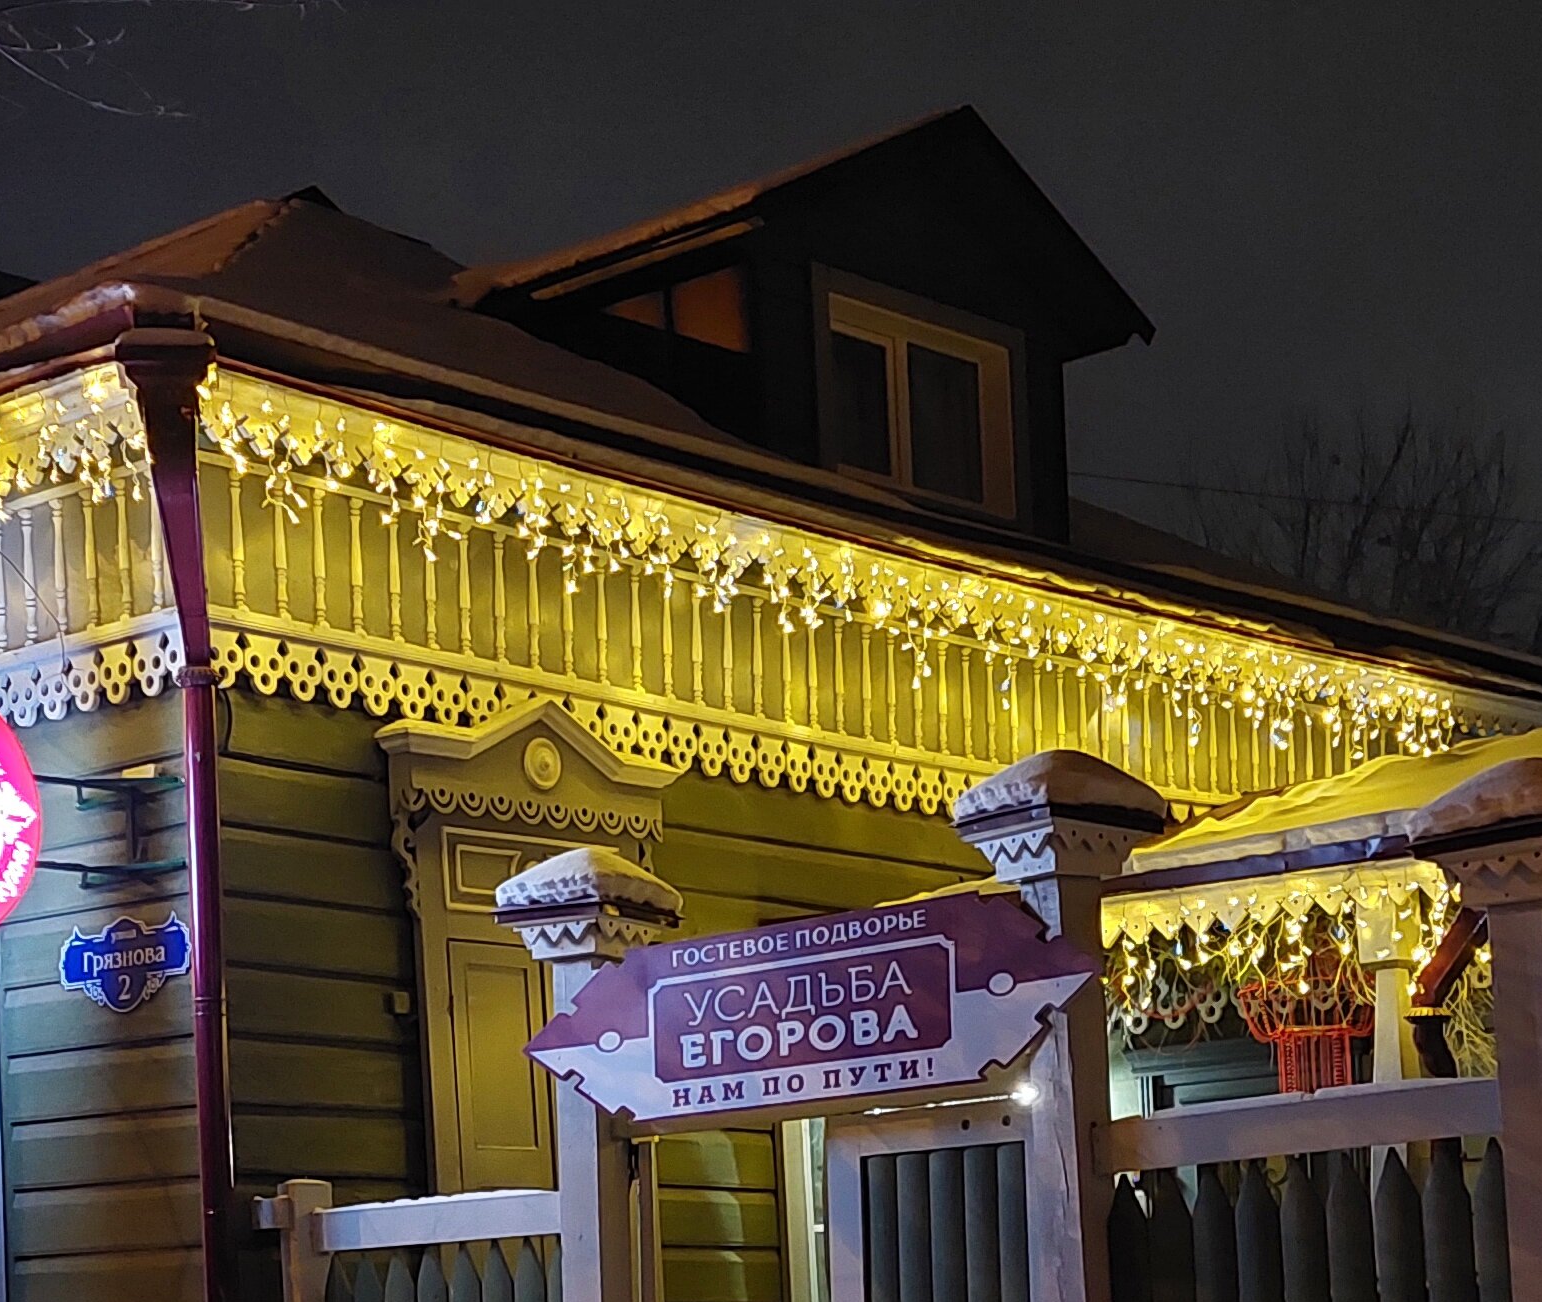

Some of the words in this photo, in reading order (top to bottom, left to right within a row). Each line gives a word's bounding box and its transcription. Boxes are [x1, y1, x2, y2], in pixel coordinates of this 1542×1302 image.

[83, 945, 166, 978] Грязнова
[672, 931, 790, 968] ГОСТЕВОЕ
[795, 908, 927, 950] ПОДВОРЬЕ
[117, 974, 132, 1001] 2
[684, 960, 913, 1026] УСАДЬБА
[680, 1003, 919, 1069] ЕГОРОВА
[672, 1080, 746, 1109] НАМ
[762, 1074, 805, 1098] ПО
[822, 1057, 937, 1090] ПУТИ!
